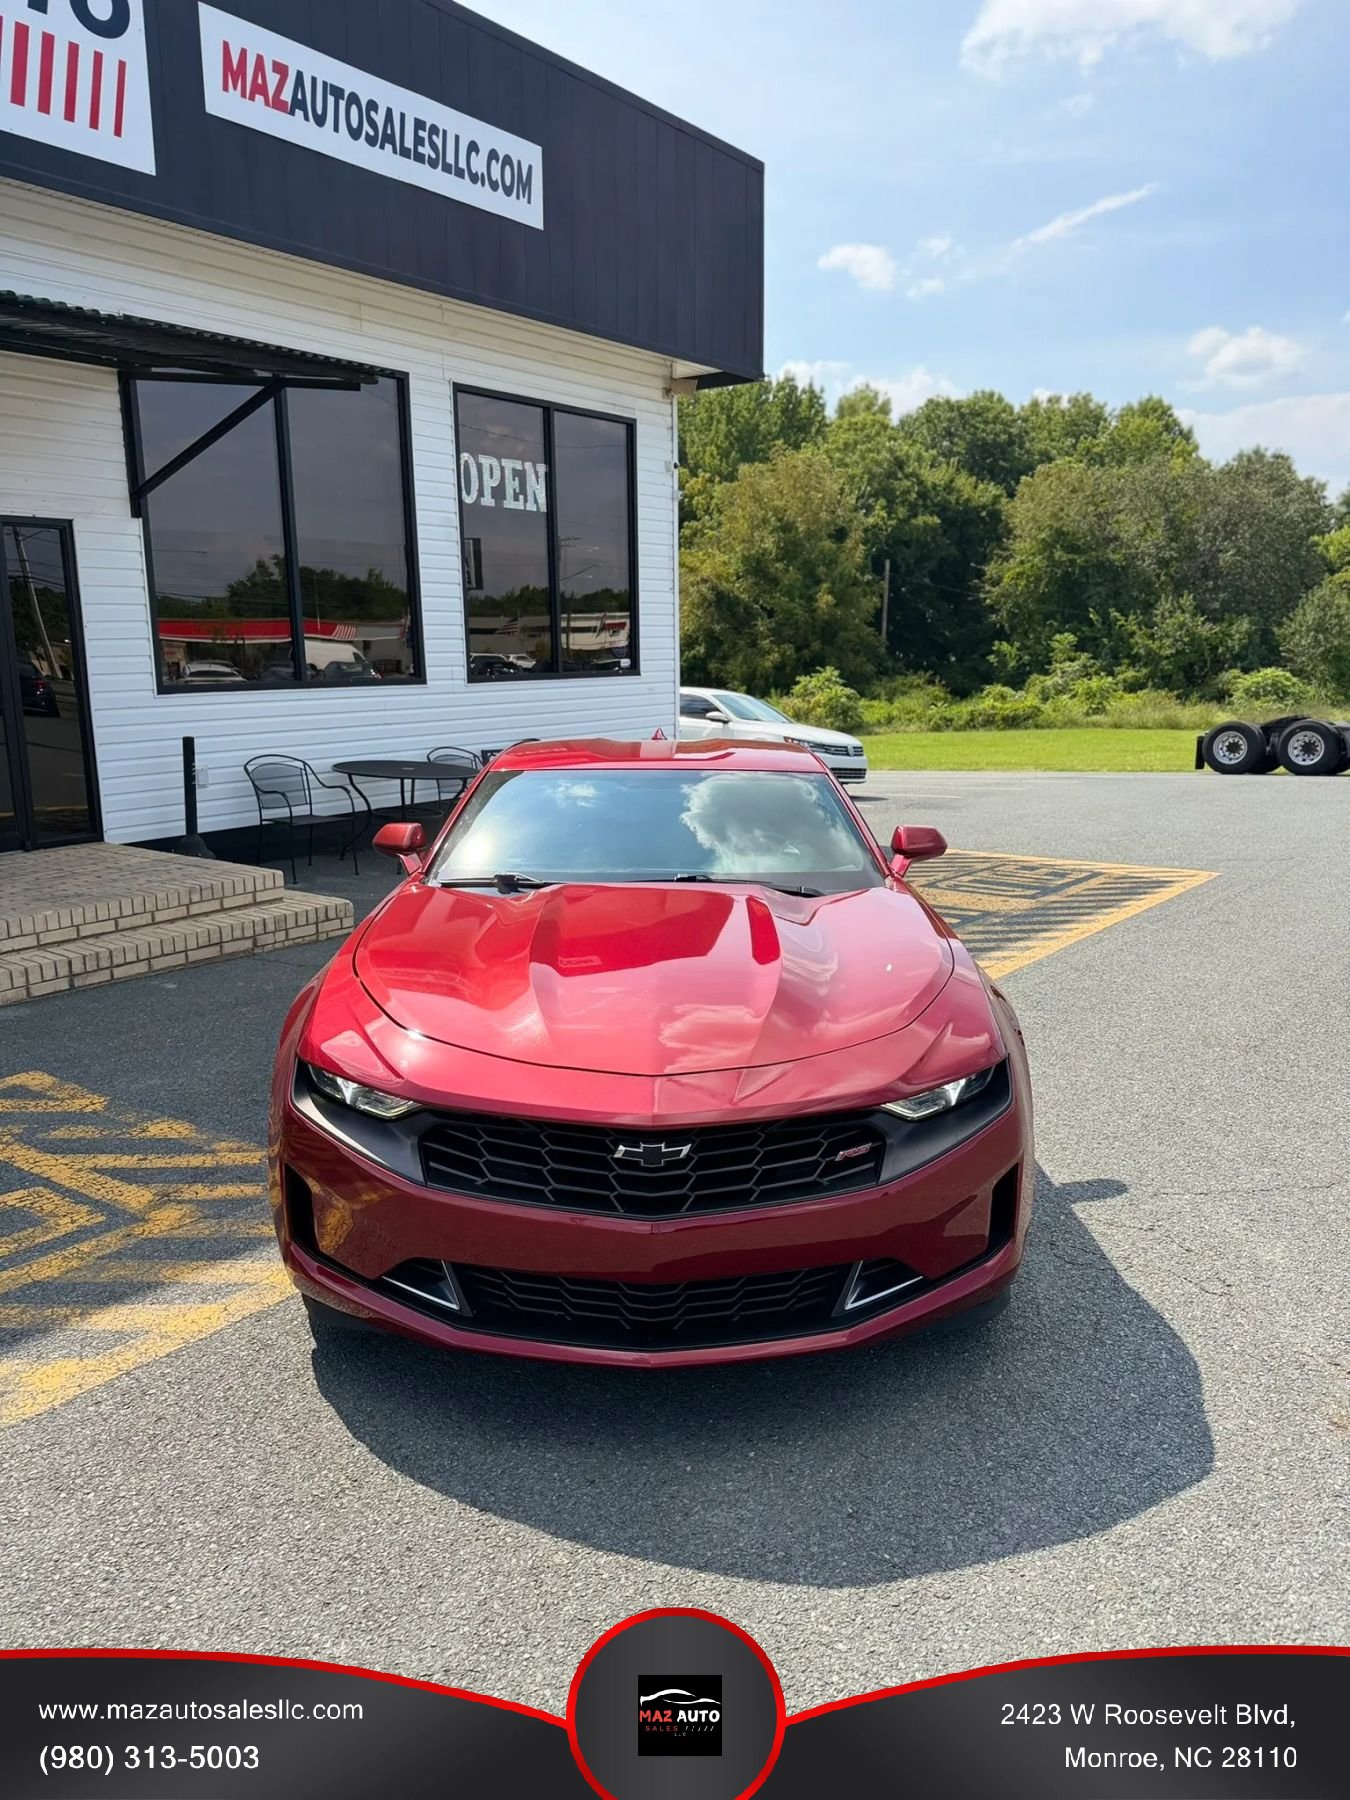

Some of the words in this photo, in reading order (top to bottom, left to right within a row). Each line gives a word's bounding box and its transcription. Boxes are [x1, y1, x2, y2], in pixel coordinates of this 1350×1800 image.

[221, 39, 534, 205] MAZAUTOSALESLLC.COM
[459, 452, 548, 512] OPEN
[834, 1142, 873, 1162] RS
